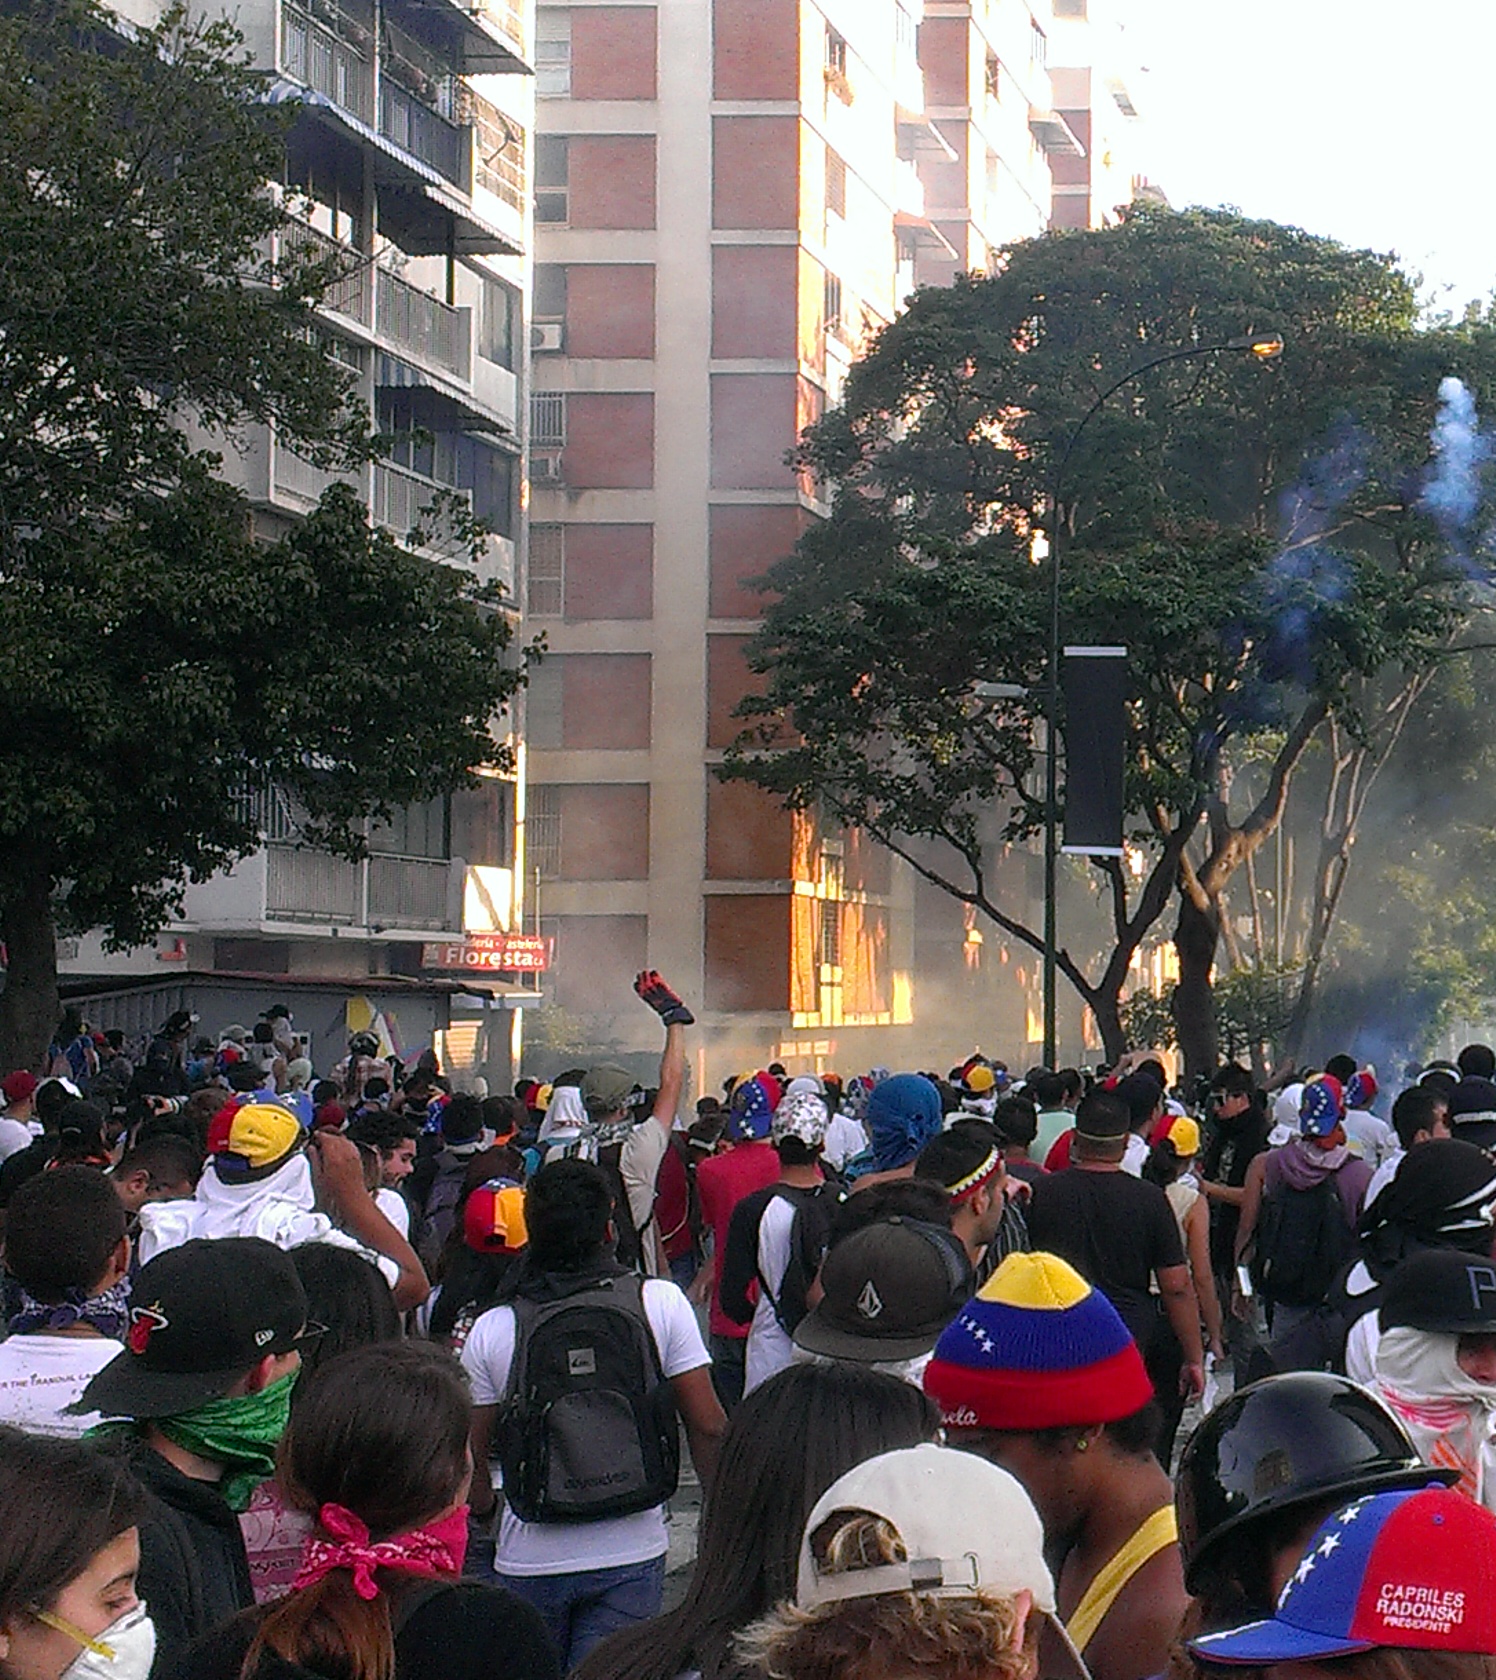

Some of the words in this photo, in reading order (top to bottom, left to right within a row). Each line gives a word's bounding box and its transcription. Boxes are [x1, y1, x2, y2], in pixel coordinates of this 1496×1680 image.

[446, 947, 533, 967] Floresta
[11, 1380, 28, 1388] THE
[1380, 1583, 1466, 1608] CAPRILES
[1376, 1598, 1464, 1625] RADONSKI
[1382, 1615, 1452, 1634] PRESIDENTE
